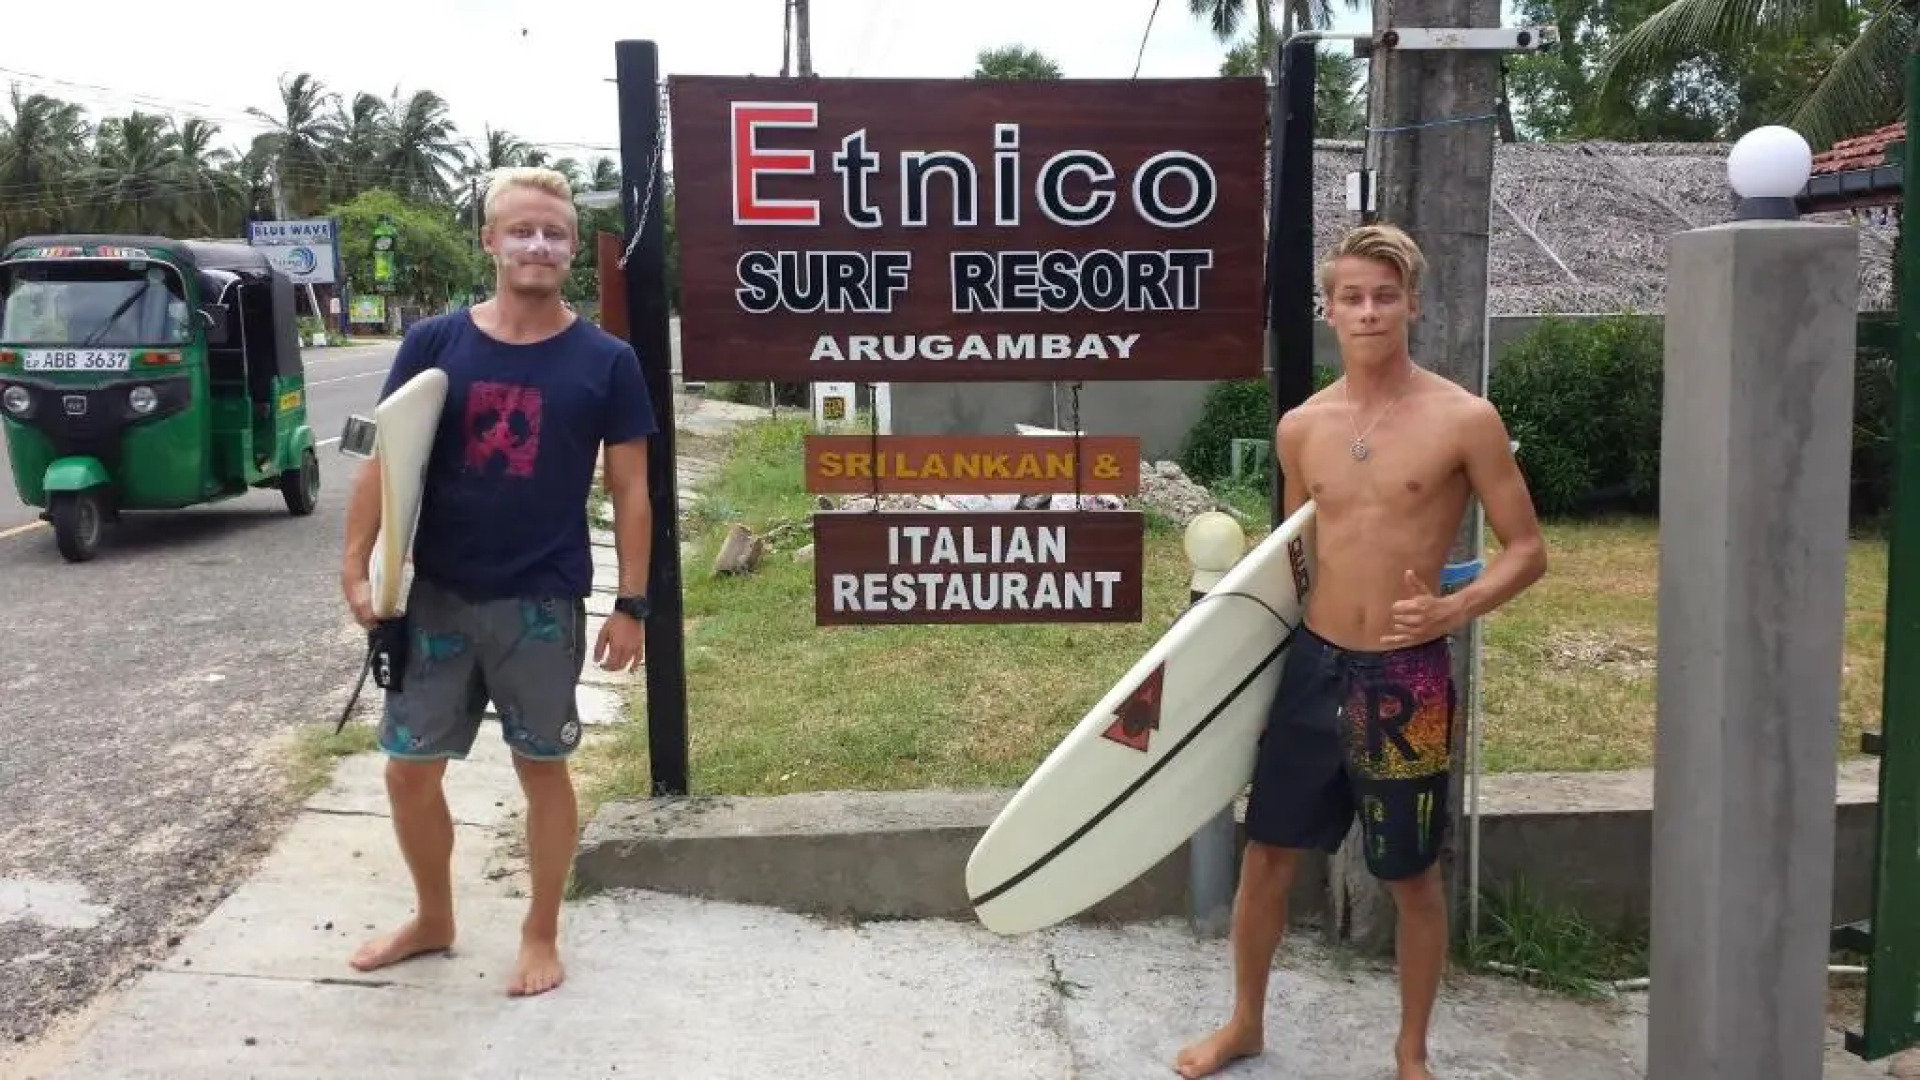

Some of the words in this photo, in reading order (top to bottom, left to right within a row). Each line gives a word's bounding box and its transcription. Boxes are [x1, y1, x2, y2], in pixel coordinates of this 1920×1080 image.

[731, 101, 1217, 228] Etnico
[254, 224, 286, 236] BLUE
[291, 224, 328, 235] WAVE
[736, 250, 911, 313] SURF
[951, 250, 1213, 312] RESORT
[42, 352, 76, 368] ABB
[84, 352, 127, 368] 3637
[809, 333, 1140, 361] ARUGAMBAY
[818, 451, 886, 478] SRI
[895, 450, 1075, 480] LANKAN
[1093, 453, 1122, 480] &
[887, 526, 1066, 565] ITALIAN
[832, 571, 1122, 612] RESTAURANT
